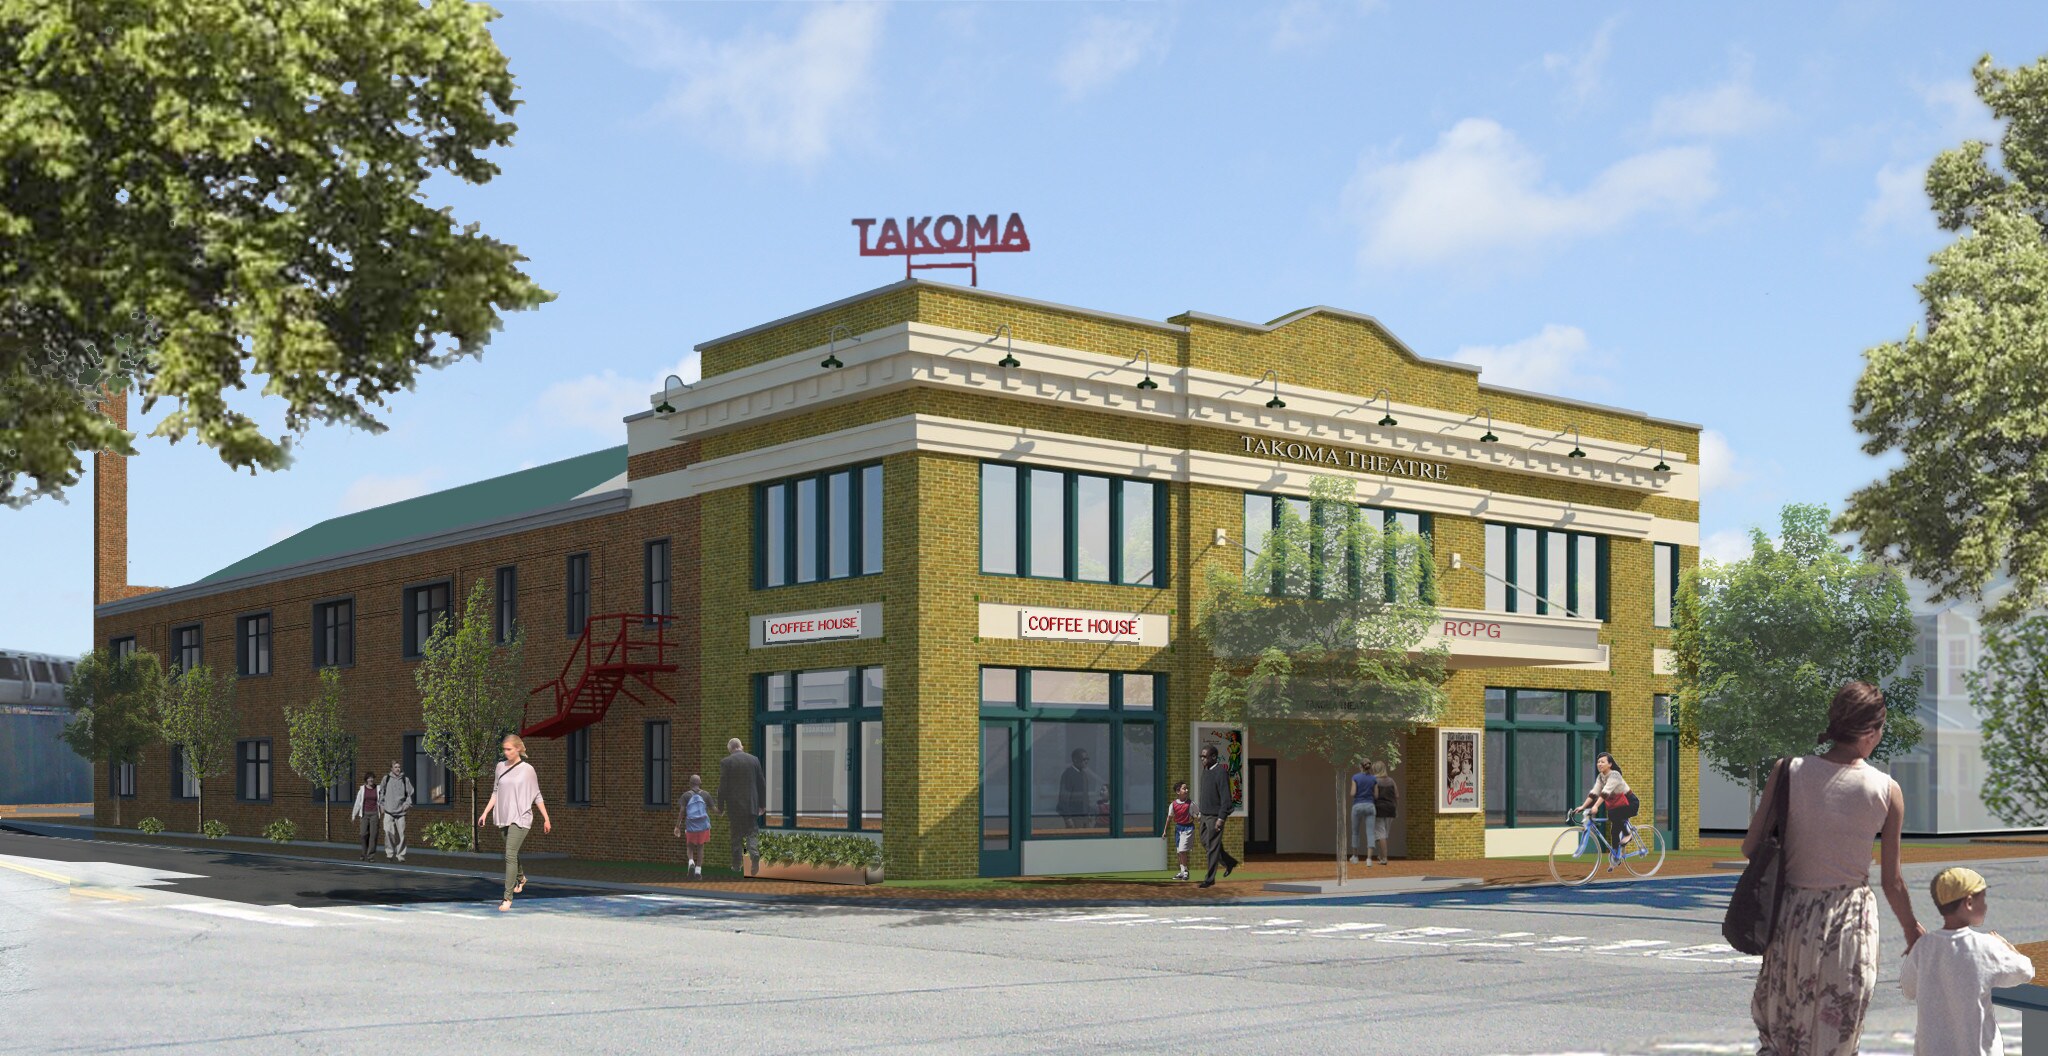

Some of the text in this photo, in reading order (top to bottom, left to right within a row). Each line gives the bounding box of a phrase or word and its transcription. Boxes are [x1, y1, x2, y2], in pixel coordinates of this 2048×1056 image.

[851, 212, 1031, 256] TAKOMA
[1240, 435, 1449, 481] TAKOMA THEATRE
[770, 616, 858, 635] COFFEE HOUSE
[1028, 615, 1137, 635] COFFEE HOUSE
[1444, 621, 1501, 638] RCPG
